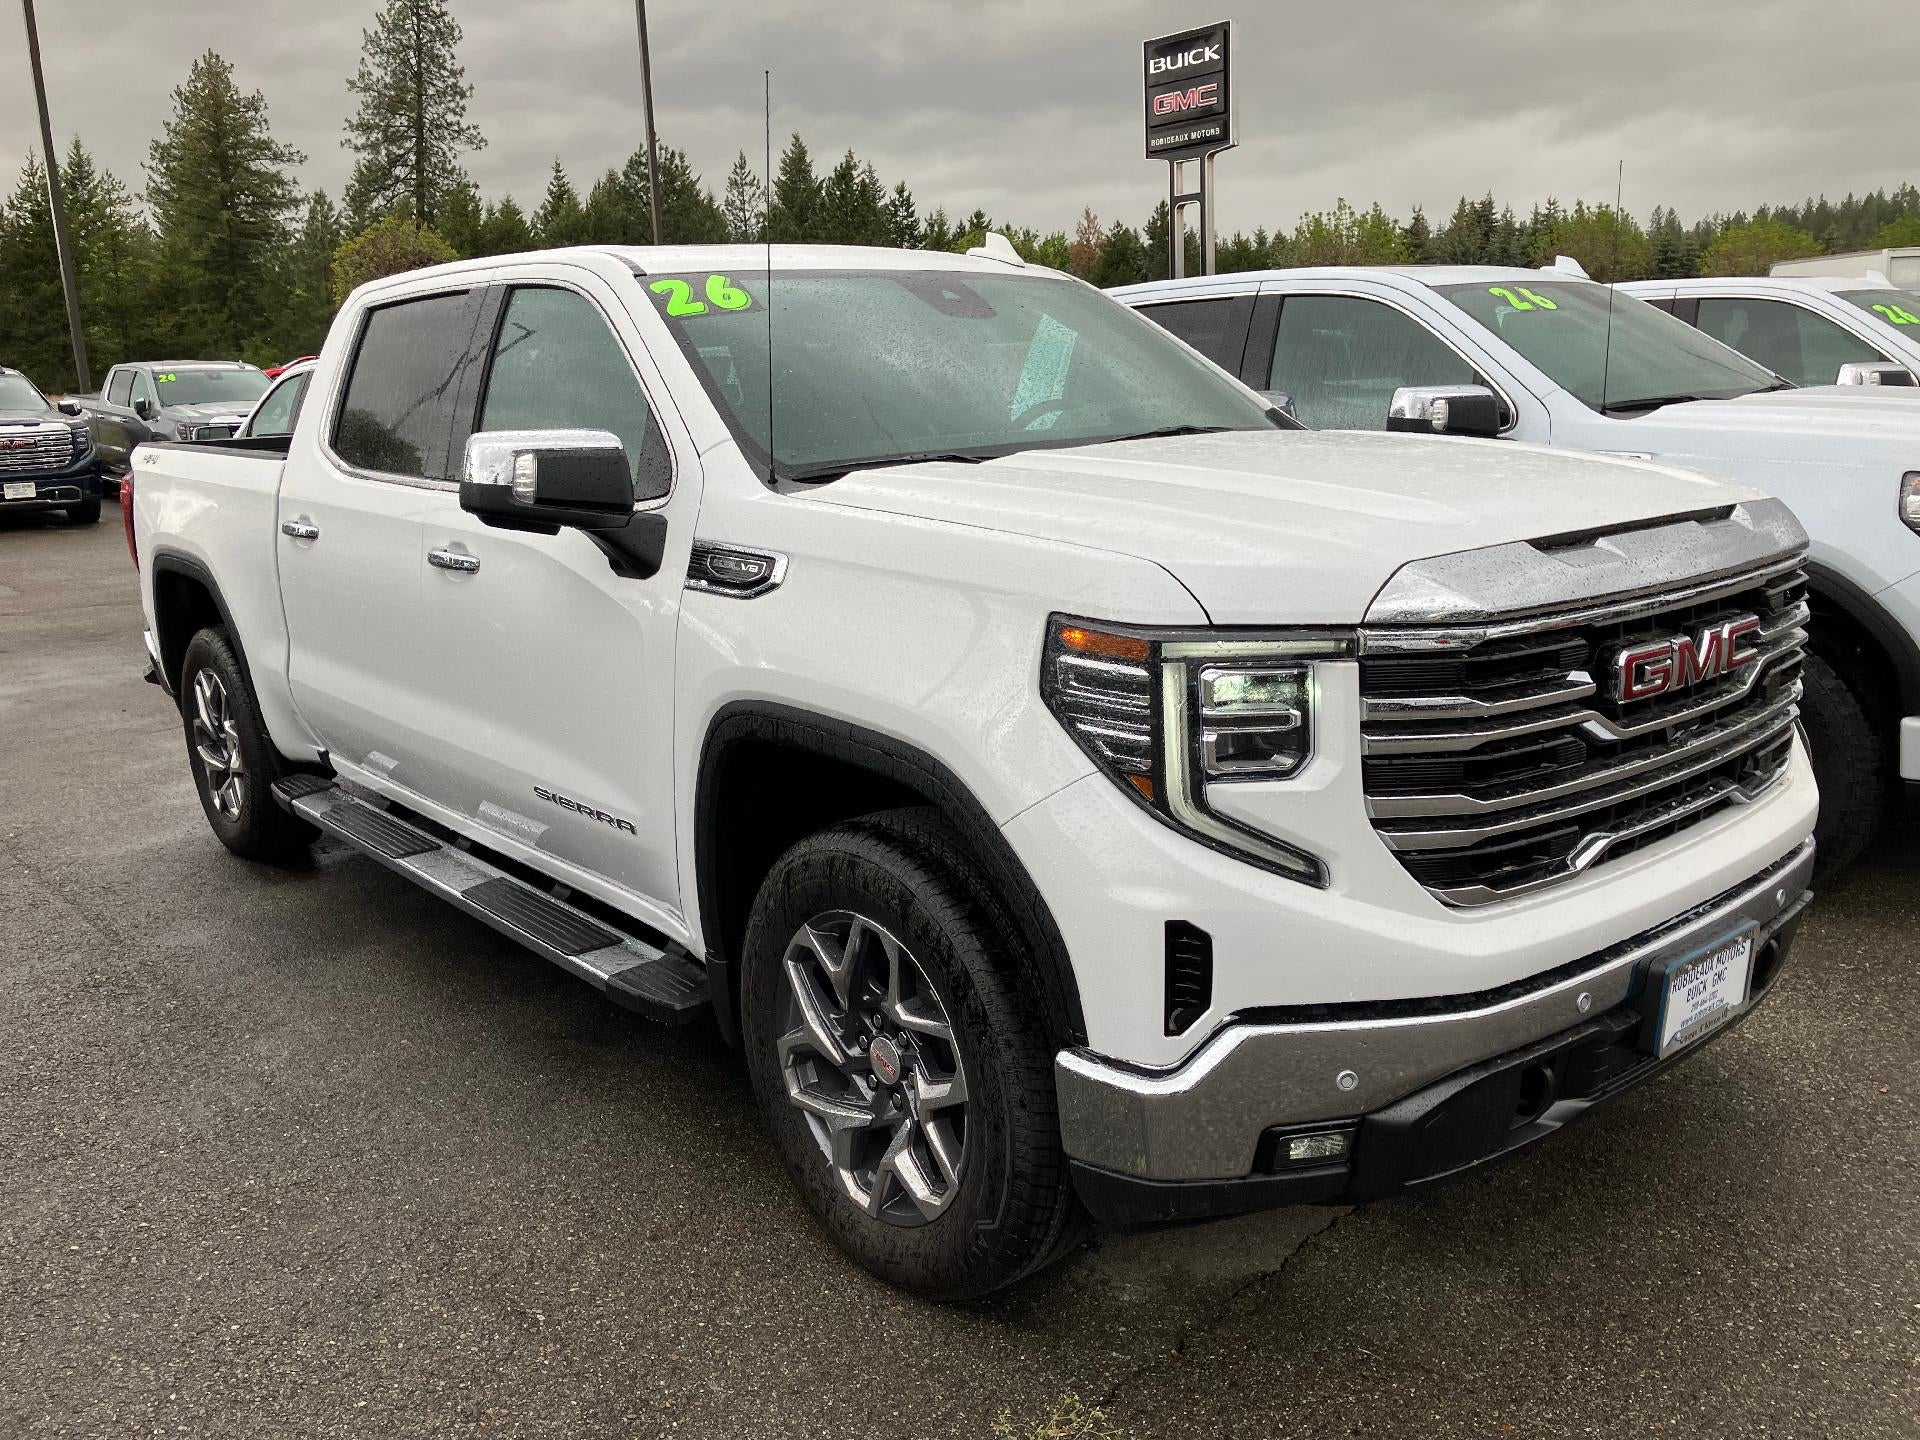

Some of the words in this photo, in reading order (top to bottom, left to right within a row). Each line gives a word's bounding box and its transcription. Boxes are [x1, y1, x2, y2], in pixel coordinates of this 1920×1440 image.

[1150, 44, 1220, 74] BUICK
[1153, 82, 1217, 115] GMC
[1151, 132, 1188, 146] ROBIDEAUX
[1190, 127, 1220, 139] MOTORS
[649, 274, 752, 317] 26
[1488, 287, 1557, 310] 26
[1872, 304, 1920, 325] 26
[1617, 614, 1760, 704] GMC
[533, 785, 638, 835] SIERRA
[1671, 958, 1714, 994] ROBIDEAUX
[1715, 941, 1746, 966] MOTORS
[1686, 978, 1708, 1003] BUICK
[1711, 966, 1728, 988] GMC
